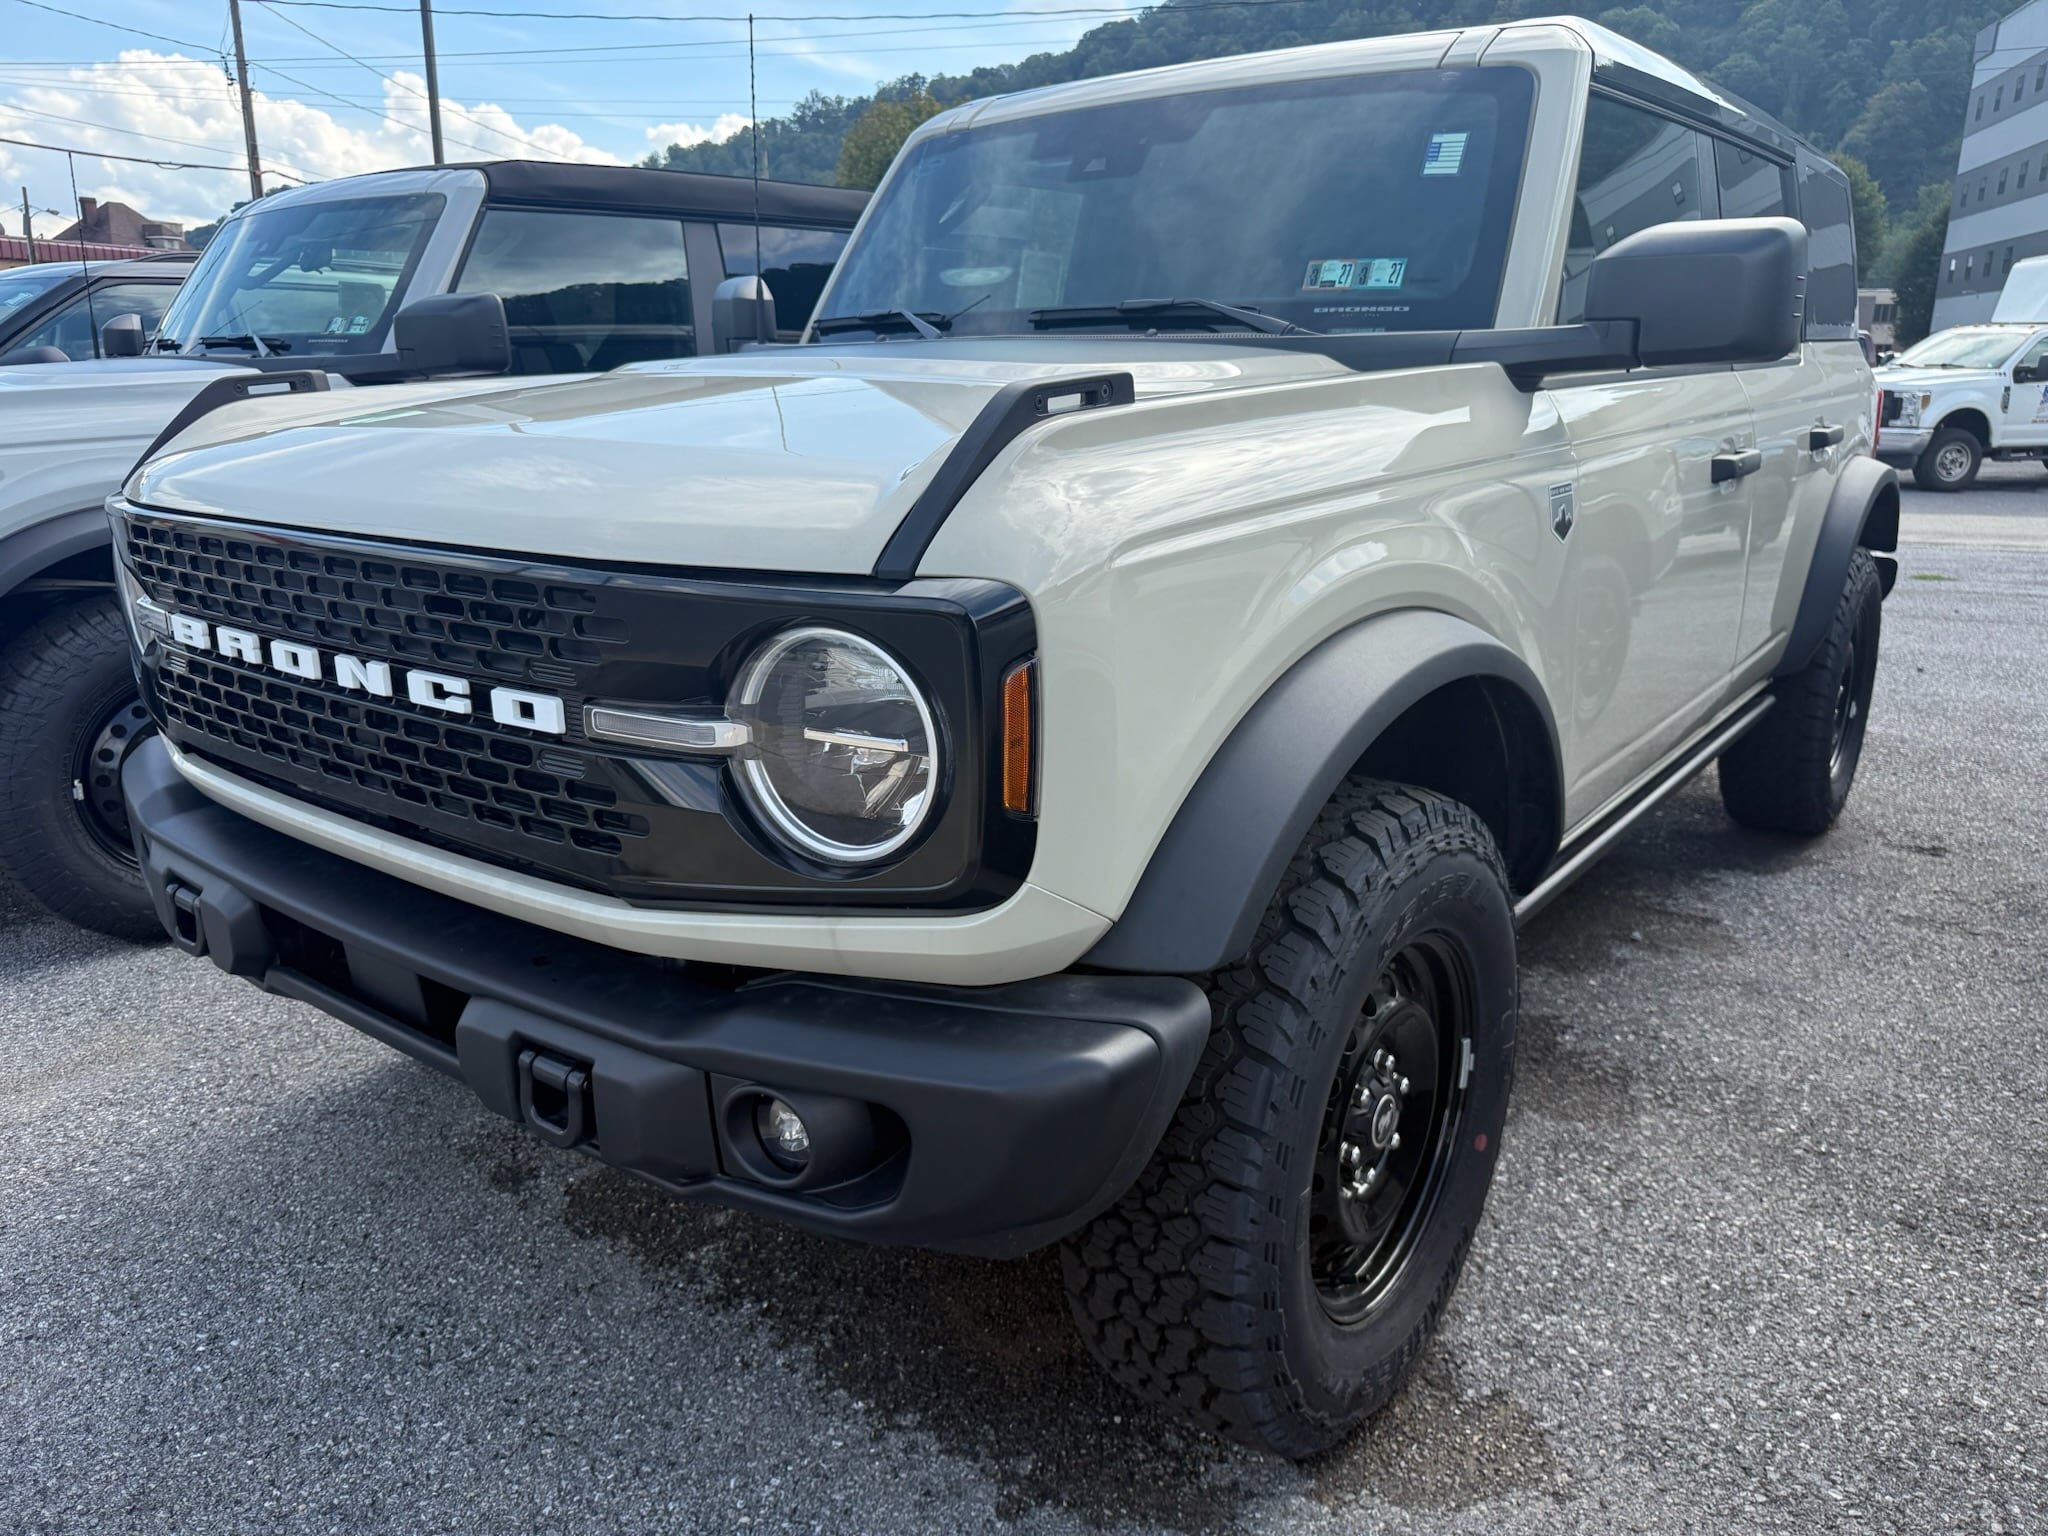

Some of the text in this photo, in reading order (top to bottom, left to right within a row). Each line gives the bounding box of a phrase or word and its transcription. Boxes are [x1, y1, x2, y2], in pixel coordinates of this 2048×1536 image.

[1338, 263, 1353, 285] 27
[1388, 262, 1403, 284] 27
[170, 613, 567, 735] BRONCO
